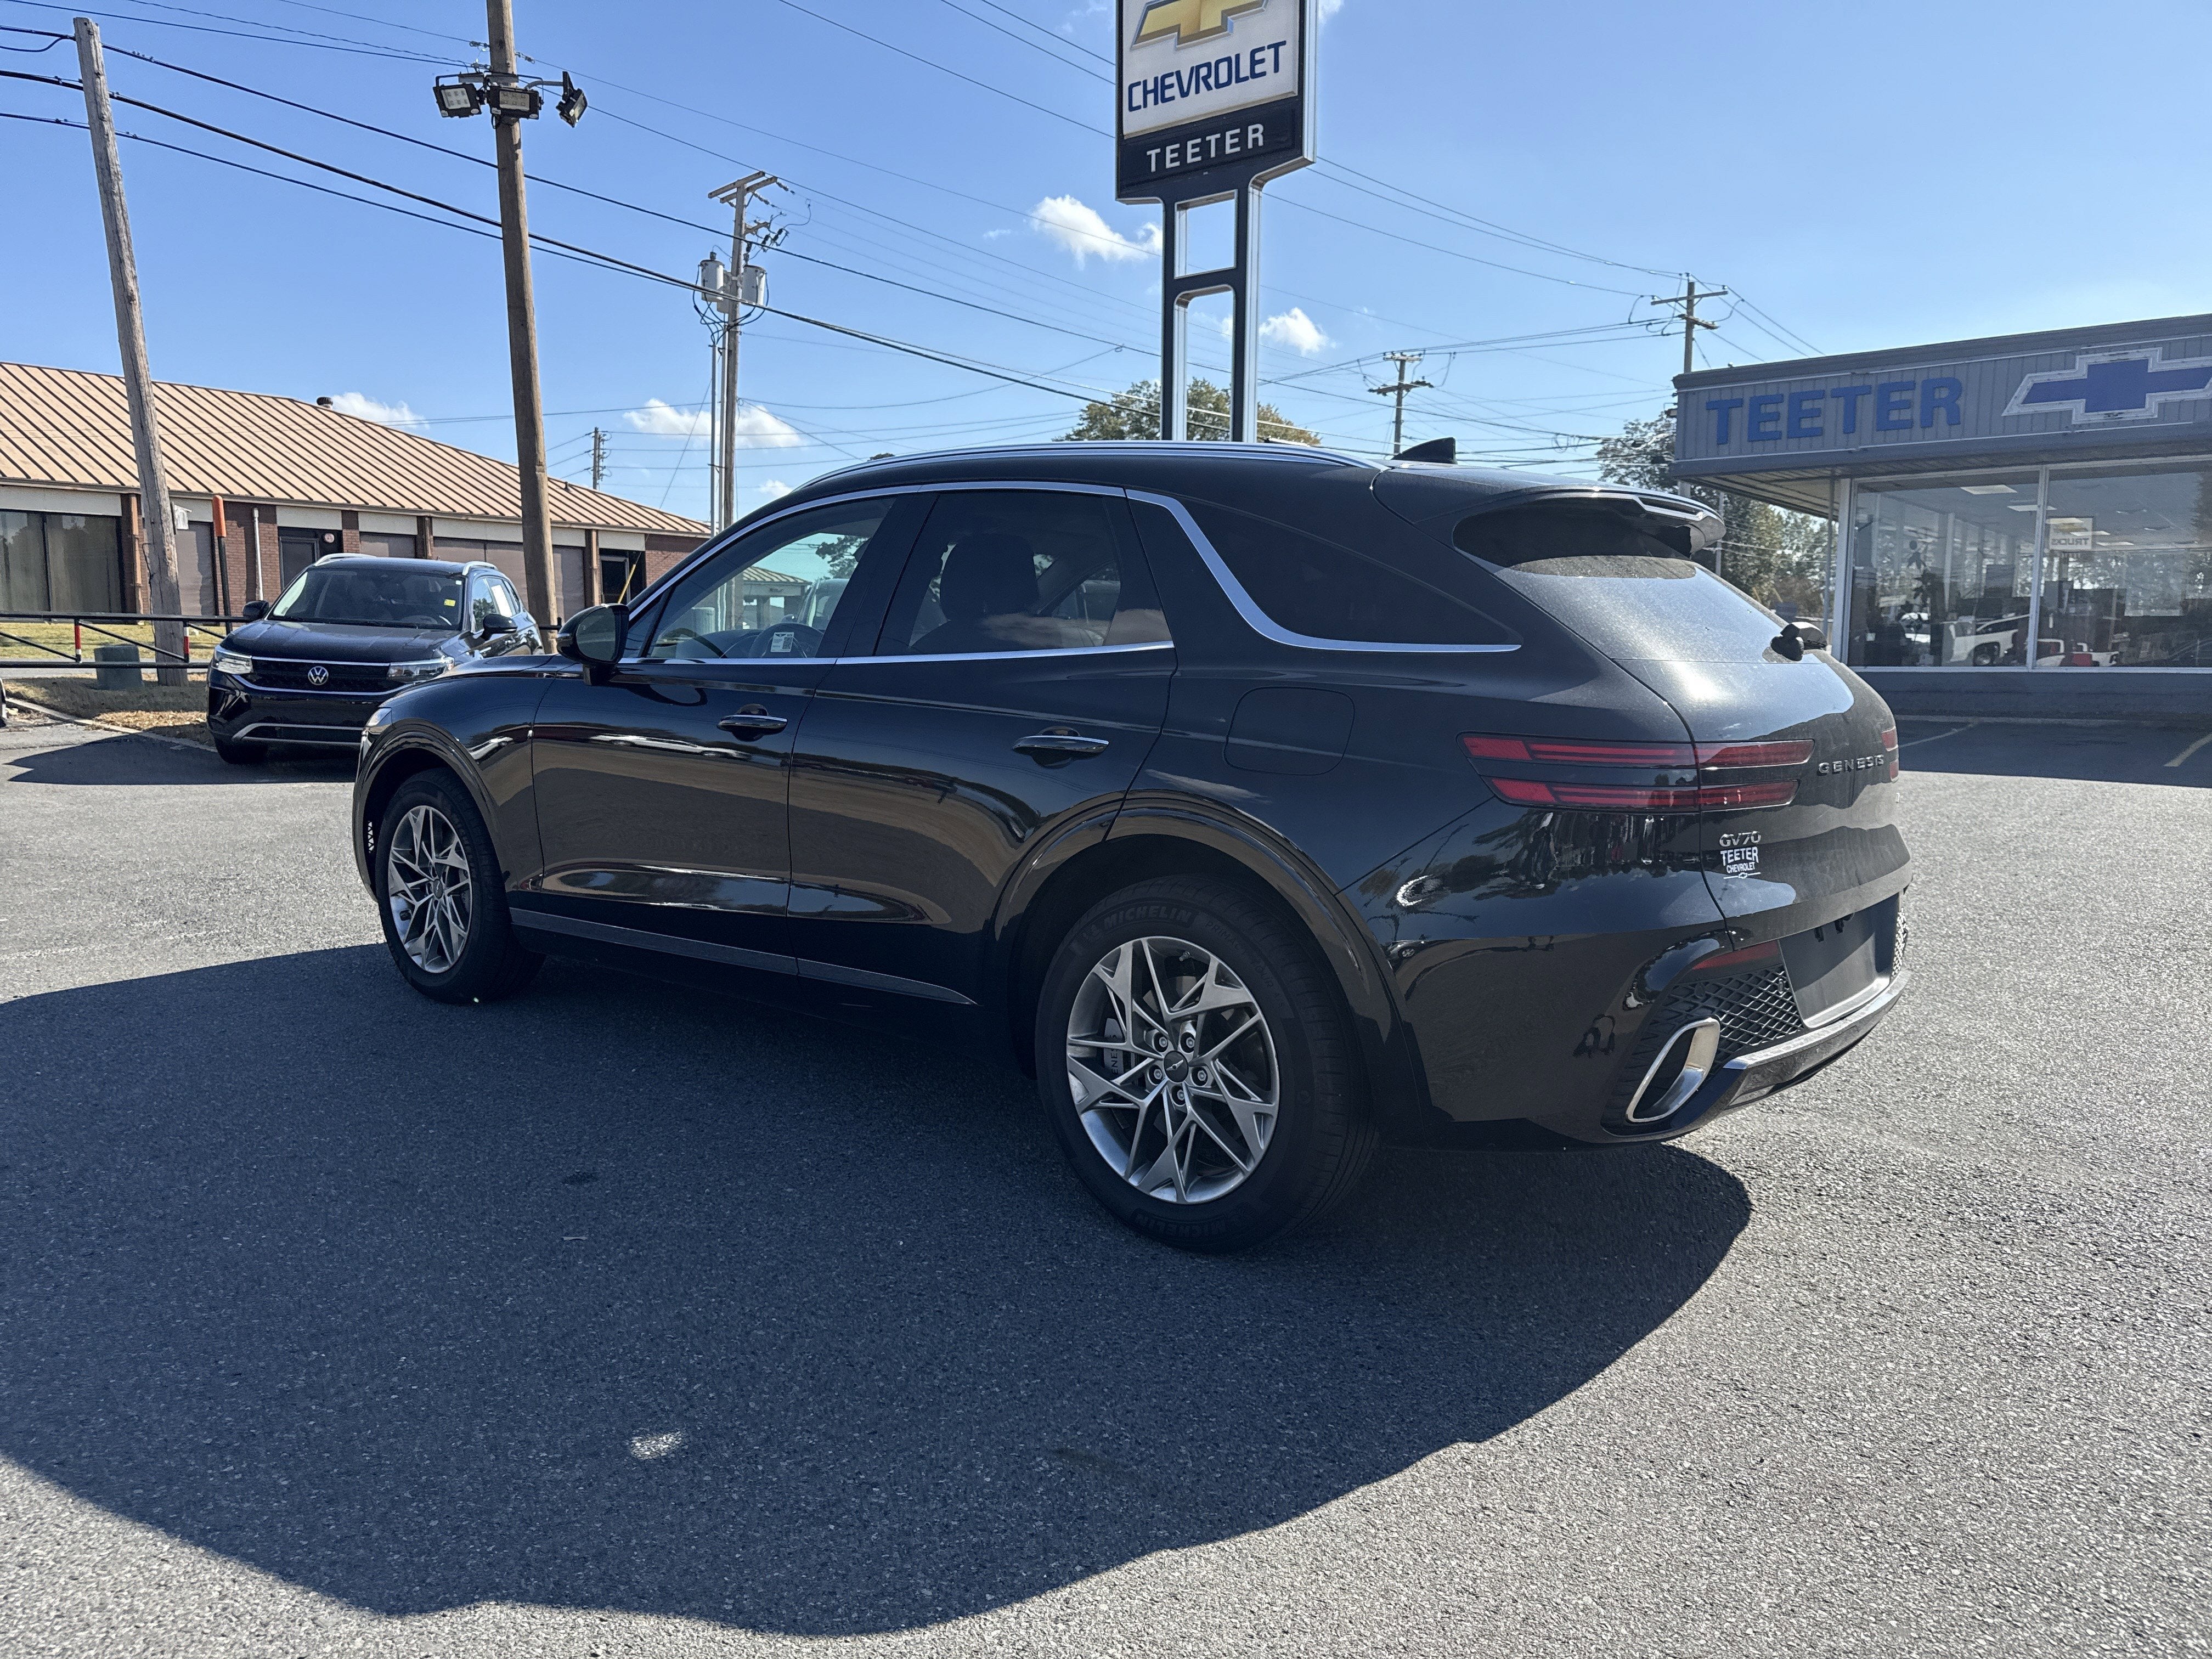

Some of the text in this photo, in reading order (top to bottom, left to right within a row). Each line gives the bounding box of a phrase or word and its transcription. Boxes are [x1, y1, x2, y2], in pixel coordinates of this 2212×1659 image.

[1128, 41, 1286, 112] CHEVROLET
[1147, 123, 1264, 173] TEETER
[1706, 376, 1962, 445] TEETER
[1819, 754, 1884, 774] GENESIS
[1719, 831, 1761, 847] GV70
[1720, 847, 1759, 866] TEETER
[1726, 862, 1755, 873] CHEVROLET
[1104, 905, 1192, 930] MICHELIN
